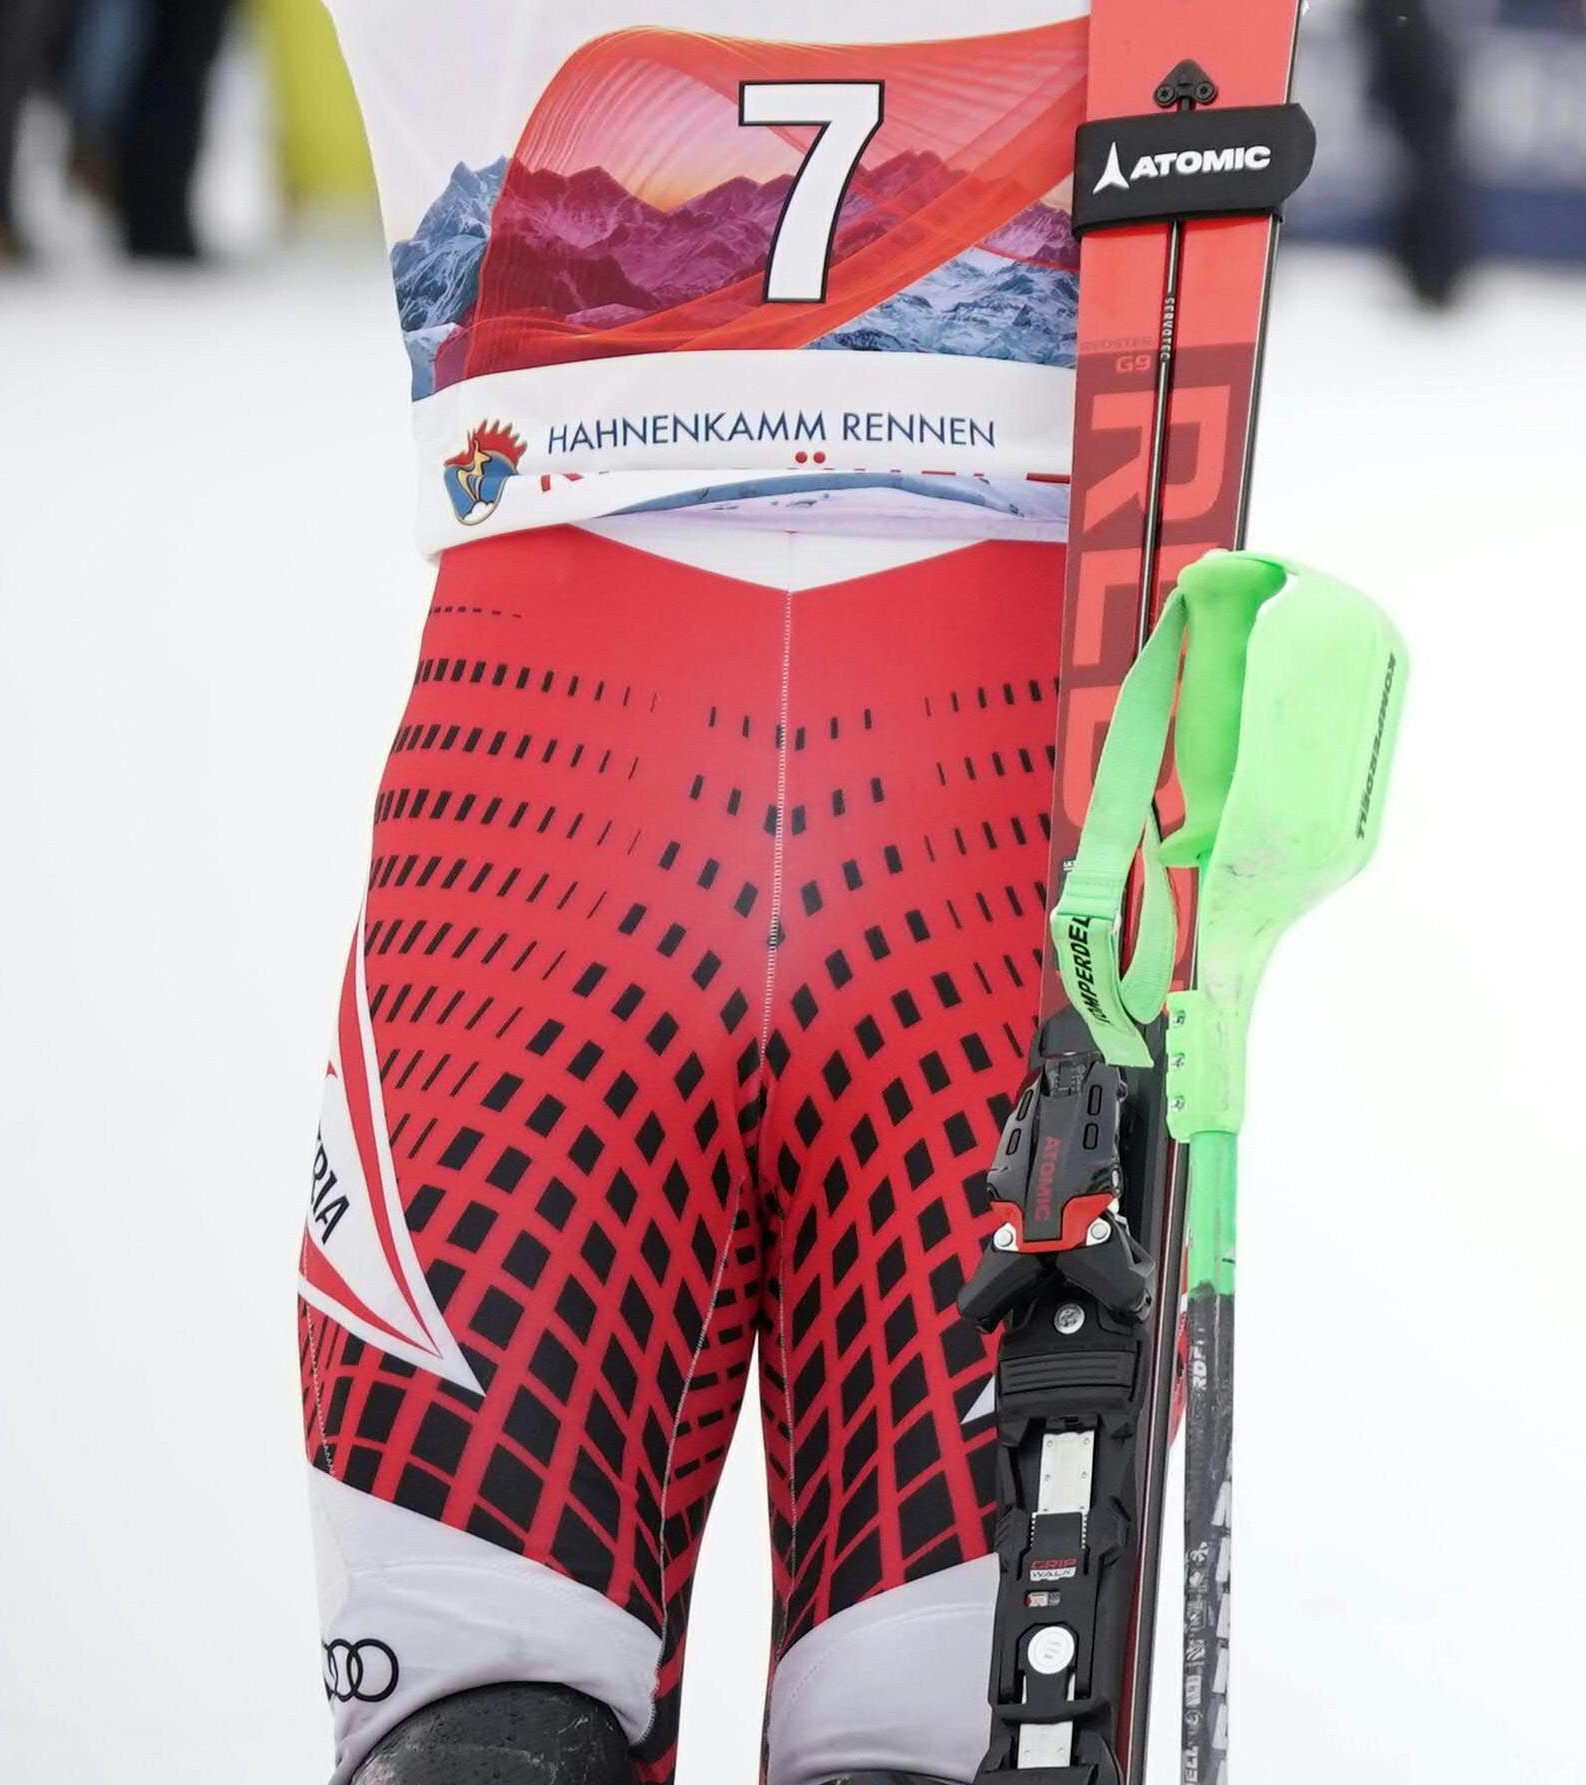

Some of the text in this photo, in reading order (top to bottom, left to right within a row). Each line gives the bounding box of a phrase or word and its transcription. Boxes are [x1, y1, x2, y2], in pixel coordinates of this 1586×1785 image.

[738, 79, 885, 305] 7
[1129, 144, 1272, 182] ATOMIC
[1160, 296, 1176, 362] SERVOTEC
[1115, 354, 1152, 375] G9
[547, 409, 996, 456] HAHNENKAMM RENNEN
[1355, 652, 1398, 841] KOMPERDELL
[1035, 1135, 1061, 1222] ATOMIC
